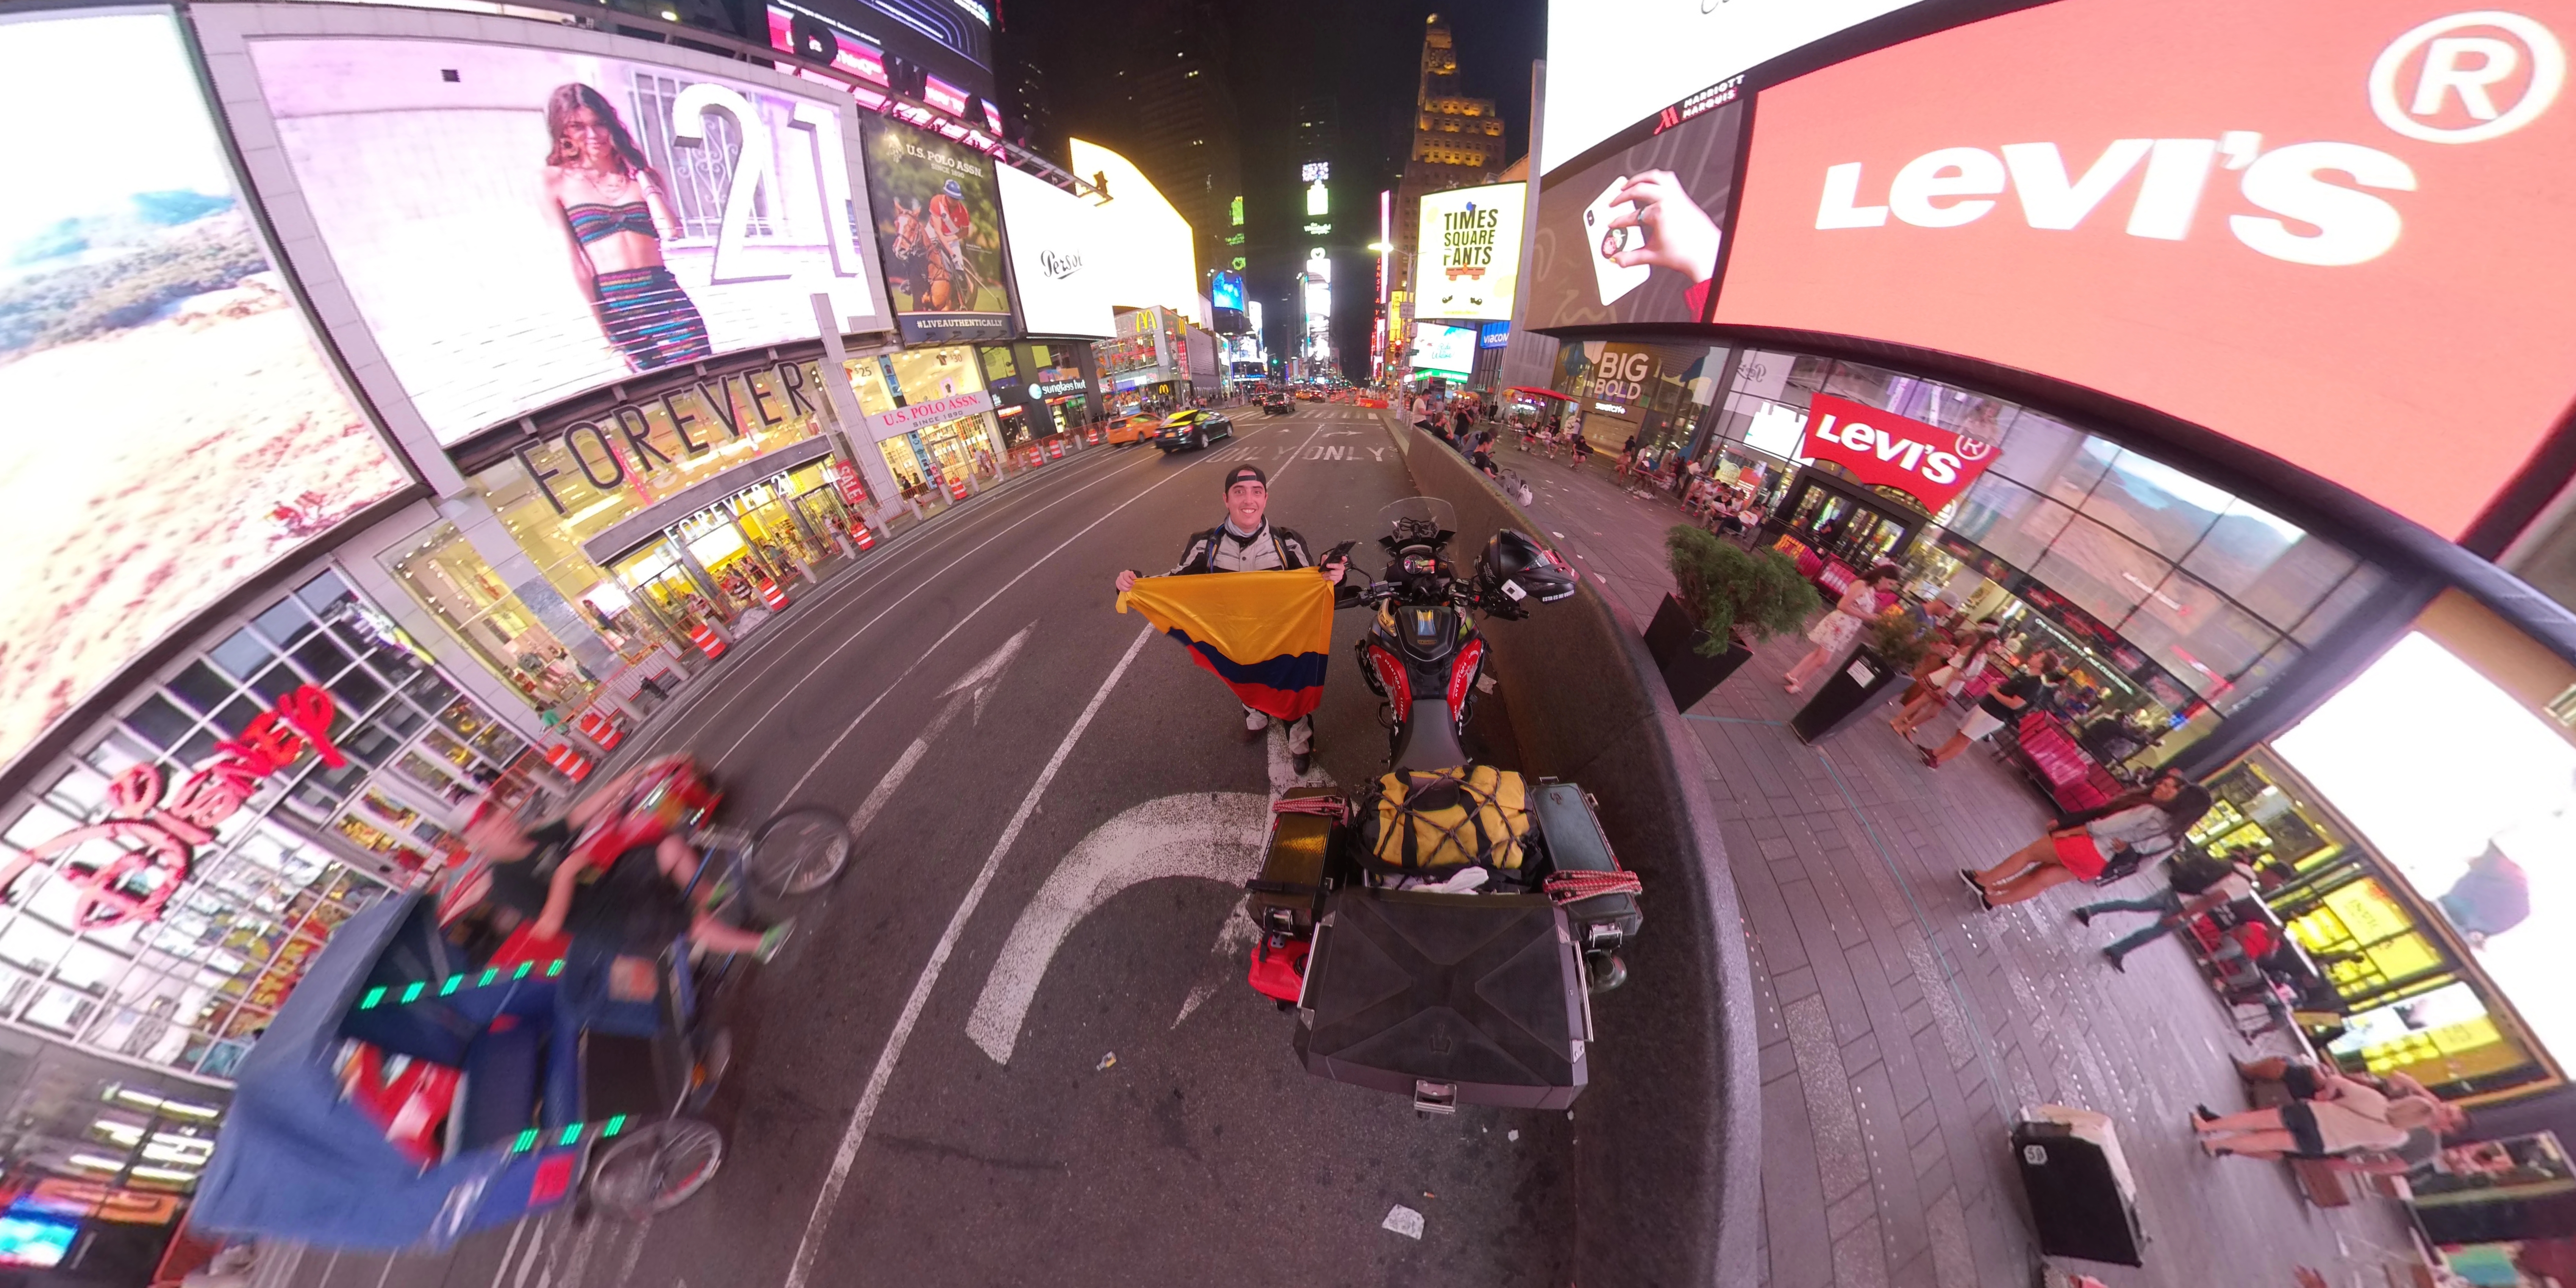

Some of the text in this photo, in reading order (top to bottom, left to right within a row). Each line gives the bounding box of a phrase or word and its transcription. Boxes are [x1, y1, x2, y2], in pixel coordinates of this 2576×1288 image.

[1682, 88, 1737, 119] MARQUIS
[1684, 74, 1745, 108] MARRIOTT
[906, 144, 983, 178] U.S. POLO ASSN.
[931, 163, 965, 178] SINCE 1890
[672, 82, 860, 285] 21
[1444, 208, 1499, 231] TIMES
[1444, 230, 1495, 247] SQUARE
[916, 318, 1003, 329] #LIVEAUTHENTICALLY
[854, 366, 872, 378] $25
[949, 354, 963, 363] $30
[1598, 352, 1649, 382] BIG
[1042, 379, 1086, 395] sunglass hut
[1594, 378, 1641, 400] BOLD
[882, 413, 910, 426] U.S.
[910, 402, 945, 419] POLO
[948, 394, 981, 412] ASSN.
[913, 410, 963, 427] SINCE 1890
[514, 361, 816, 515] FOREVER
[1302, 446, 1385, 462] ONLY
[838, 465, 863, 500] SALE
[663, 470, 793, 559] FOREVER 21
[1384, 658, 1401, 690] AVENTURA
[1455, 662, 1467, 697] AVENTURA
